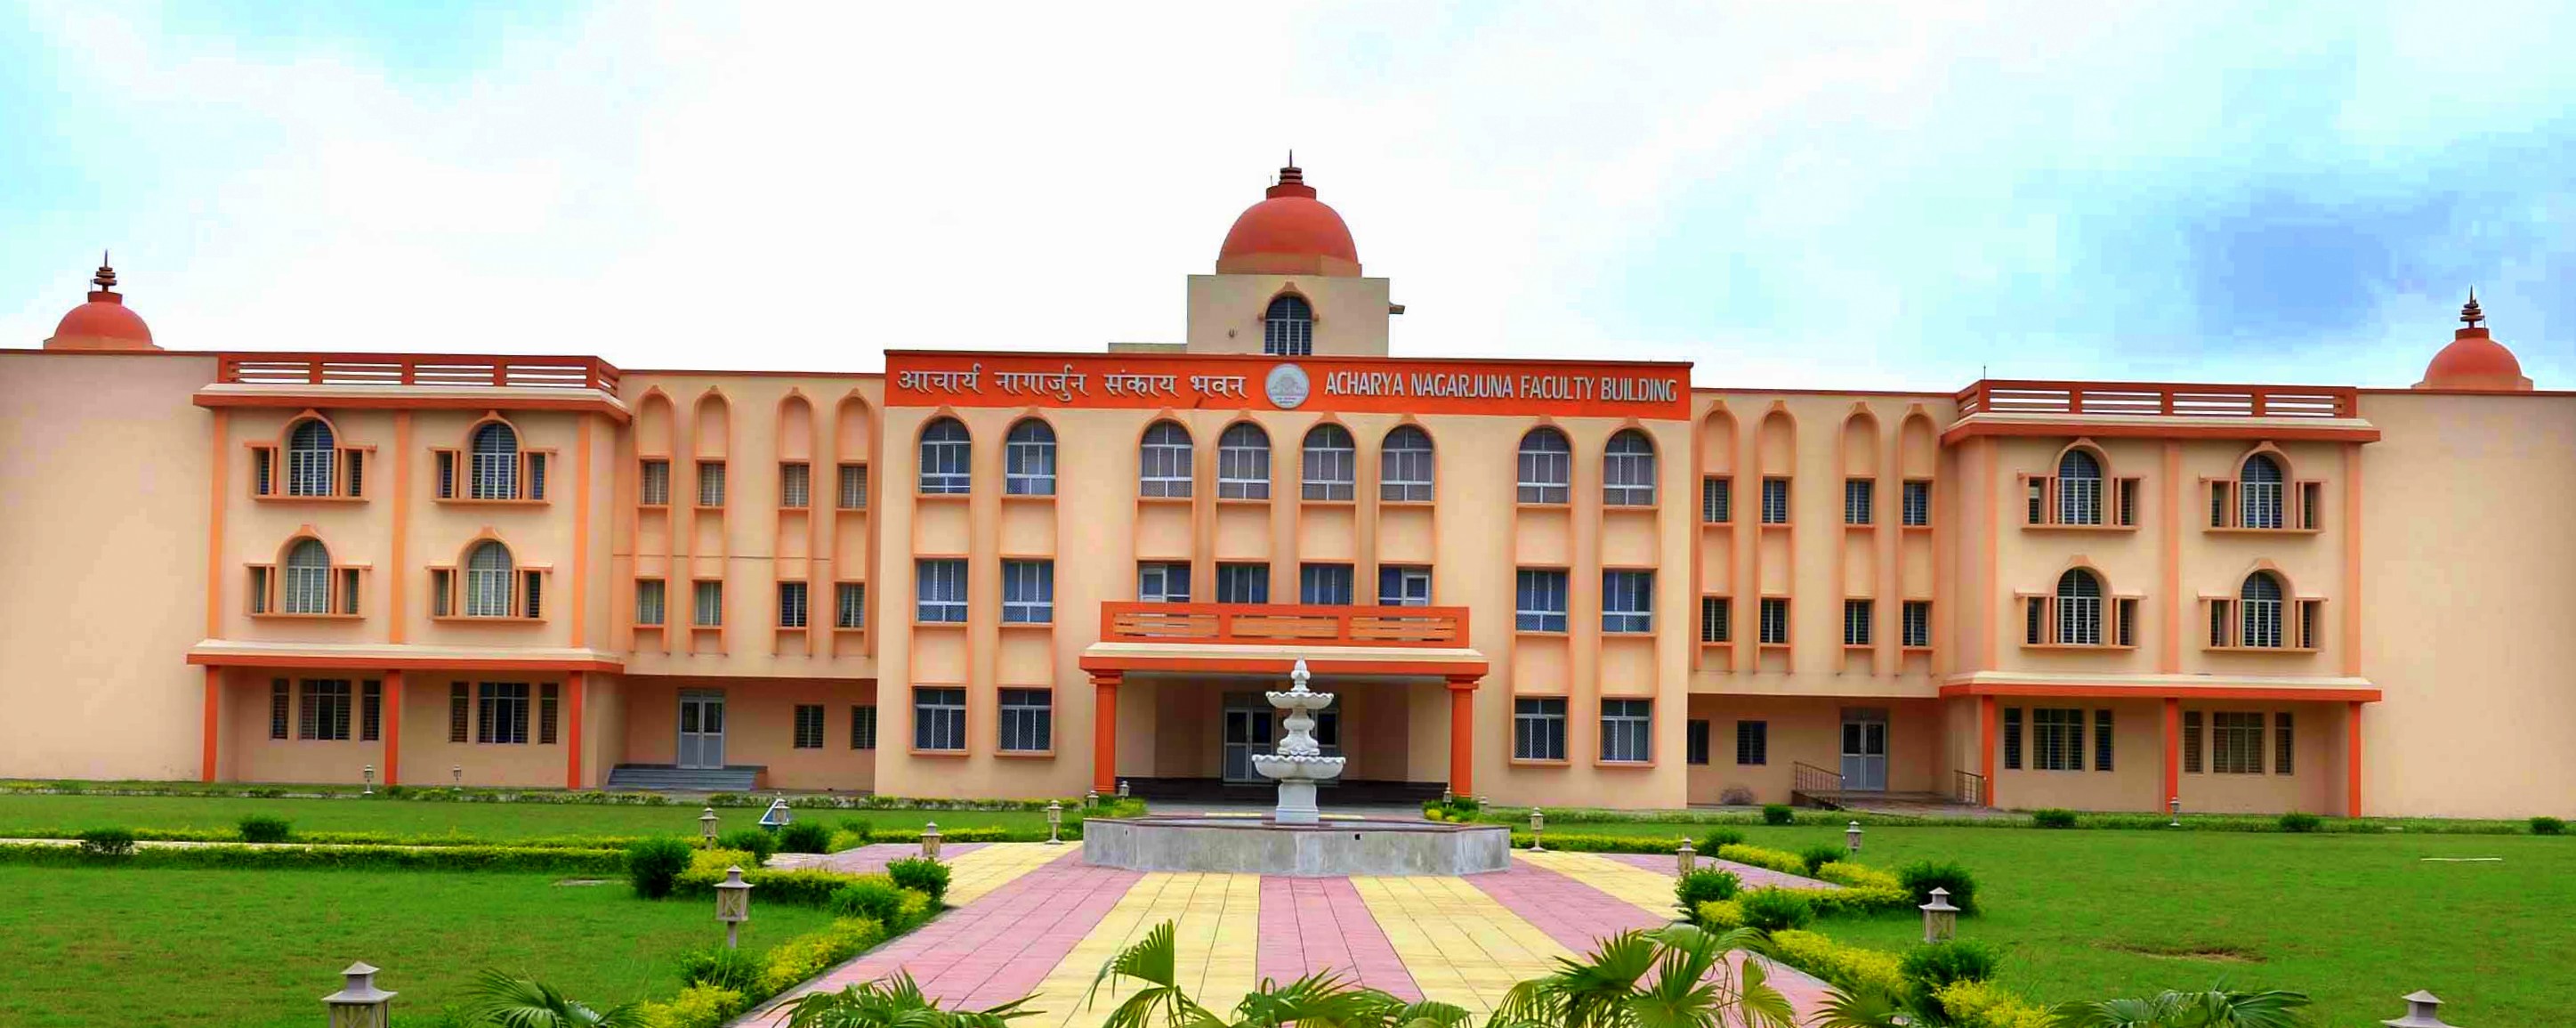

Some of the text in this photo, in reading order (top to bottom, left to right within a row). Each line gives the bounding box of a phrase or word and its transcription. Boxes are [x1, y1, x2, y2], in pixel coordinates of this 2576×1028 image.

[898, 363, 1248, 401] आचार्य नागार्जुन संकाय भवन
[1324, 372, 1678, 402] ACHARYA NAGARJUNA FACULTY BUILDING
